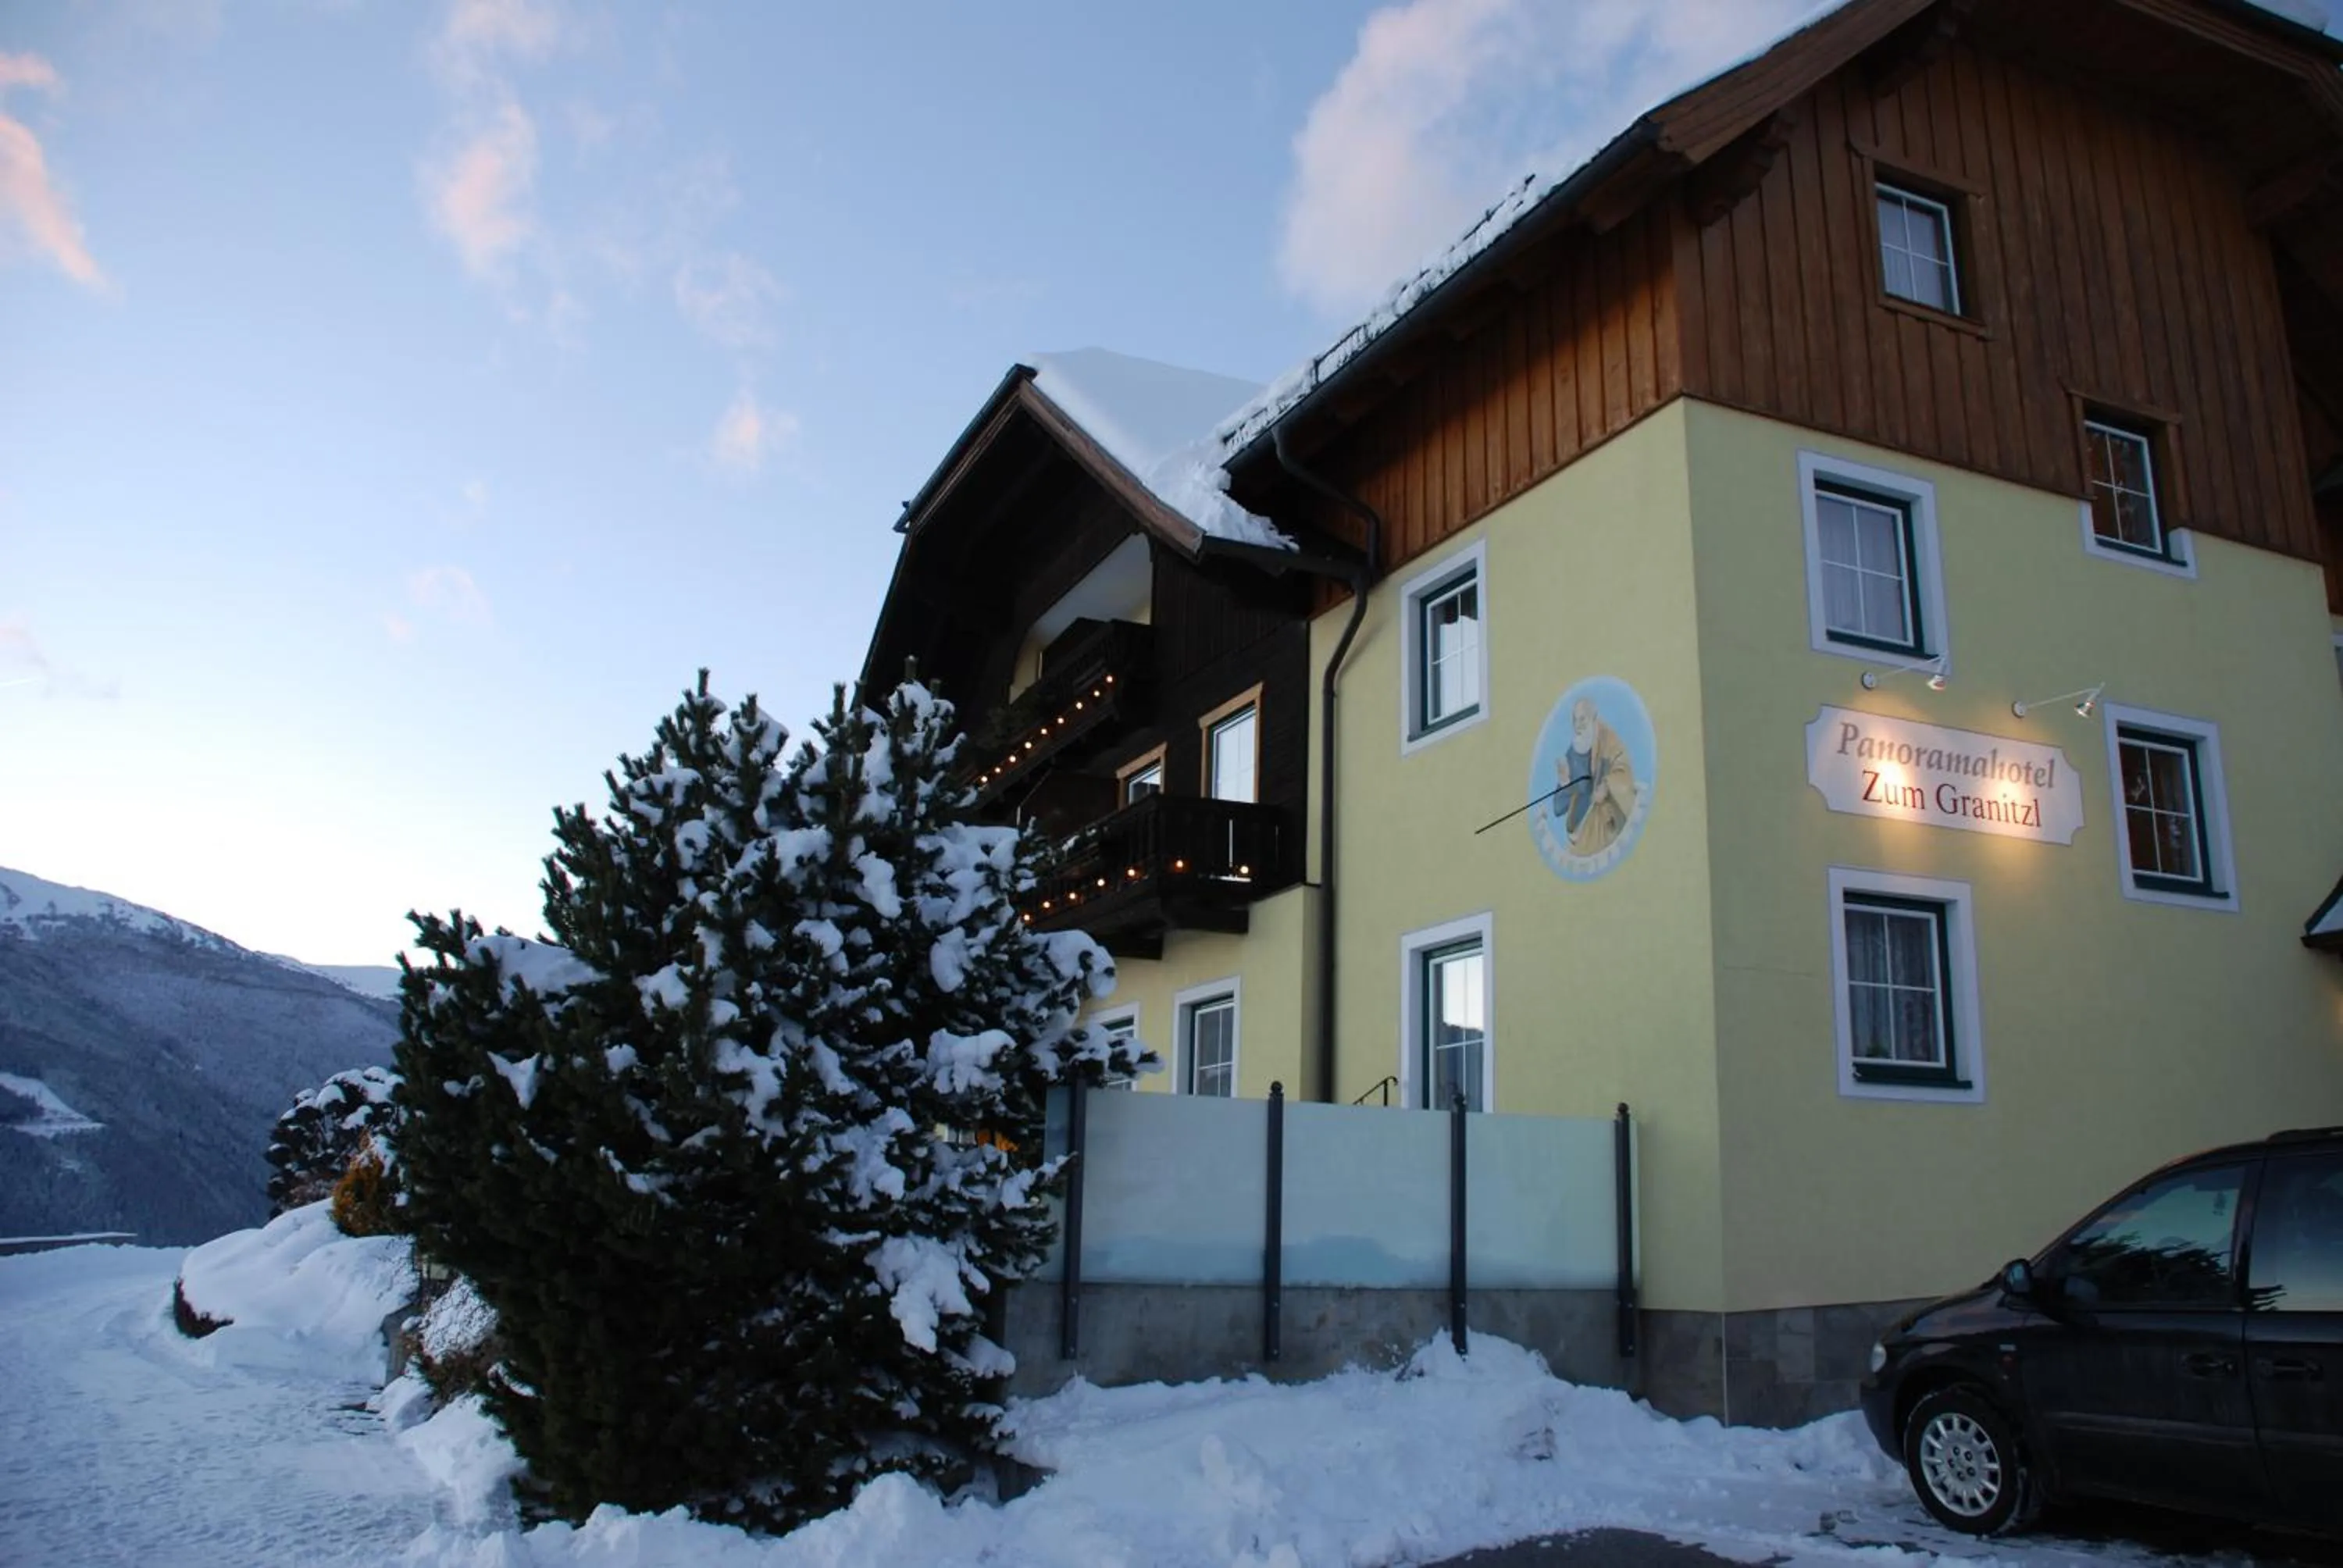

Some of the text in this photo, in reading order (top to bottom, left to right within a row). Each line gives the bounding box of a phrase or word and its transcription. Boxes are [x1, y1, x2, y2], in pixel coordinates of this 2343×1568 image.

[1838, 723, 2055, 788] Panoramahotel
[1862, 770, 2042, 828] Zum Granitzl
